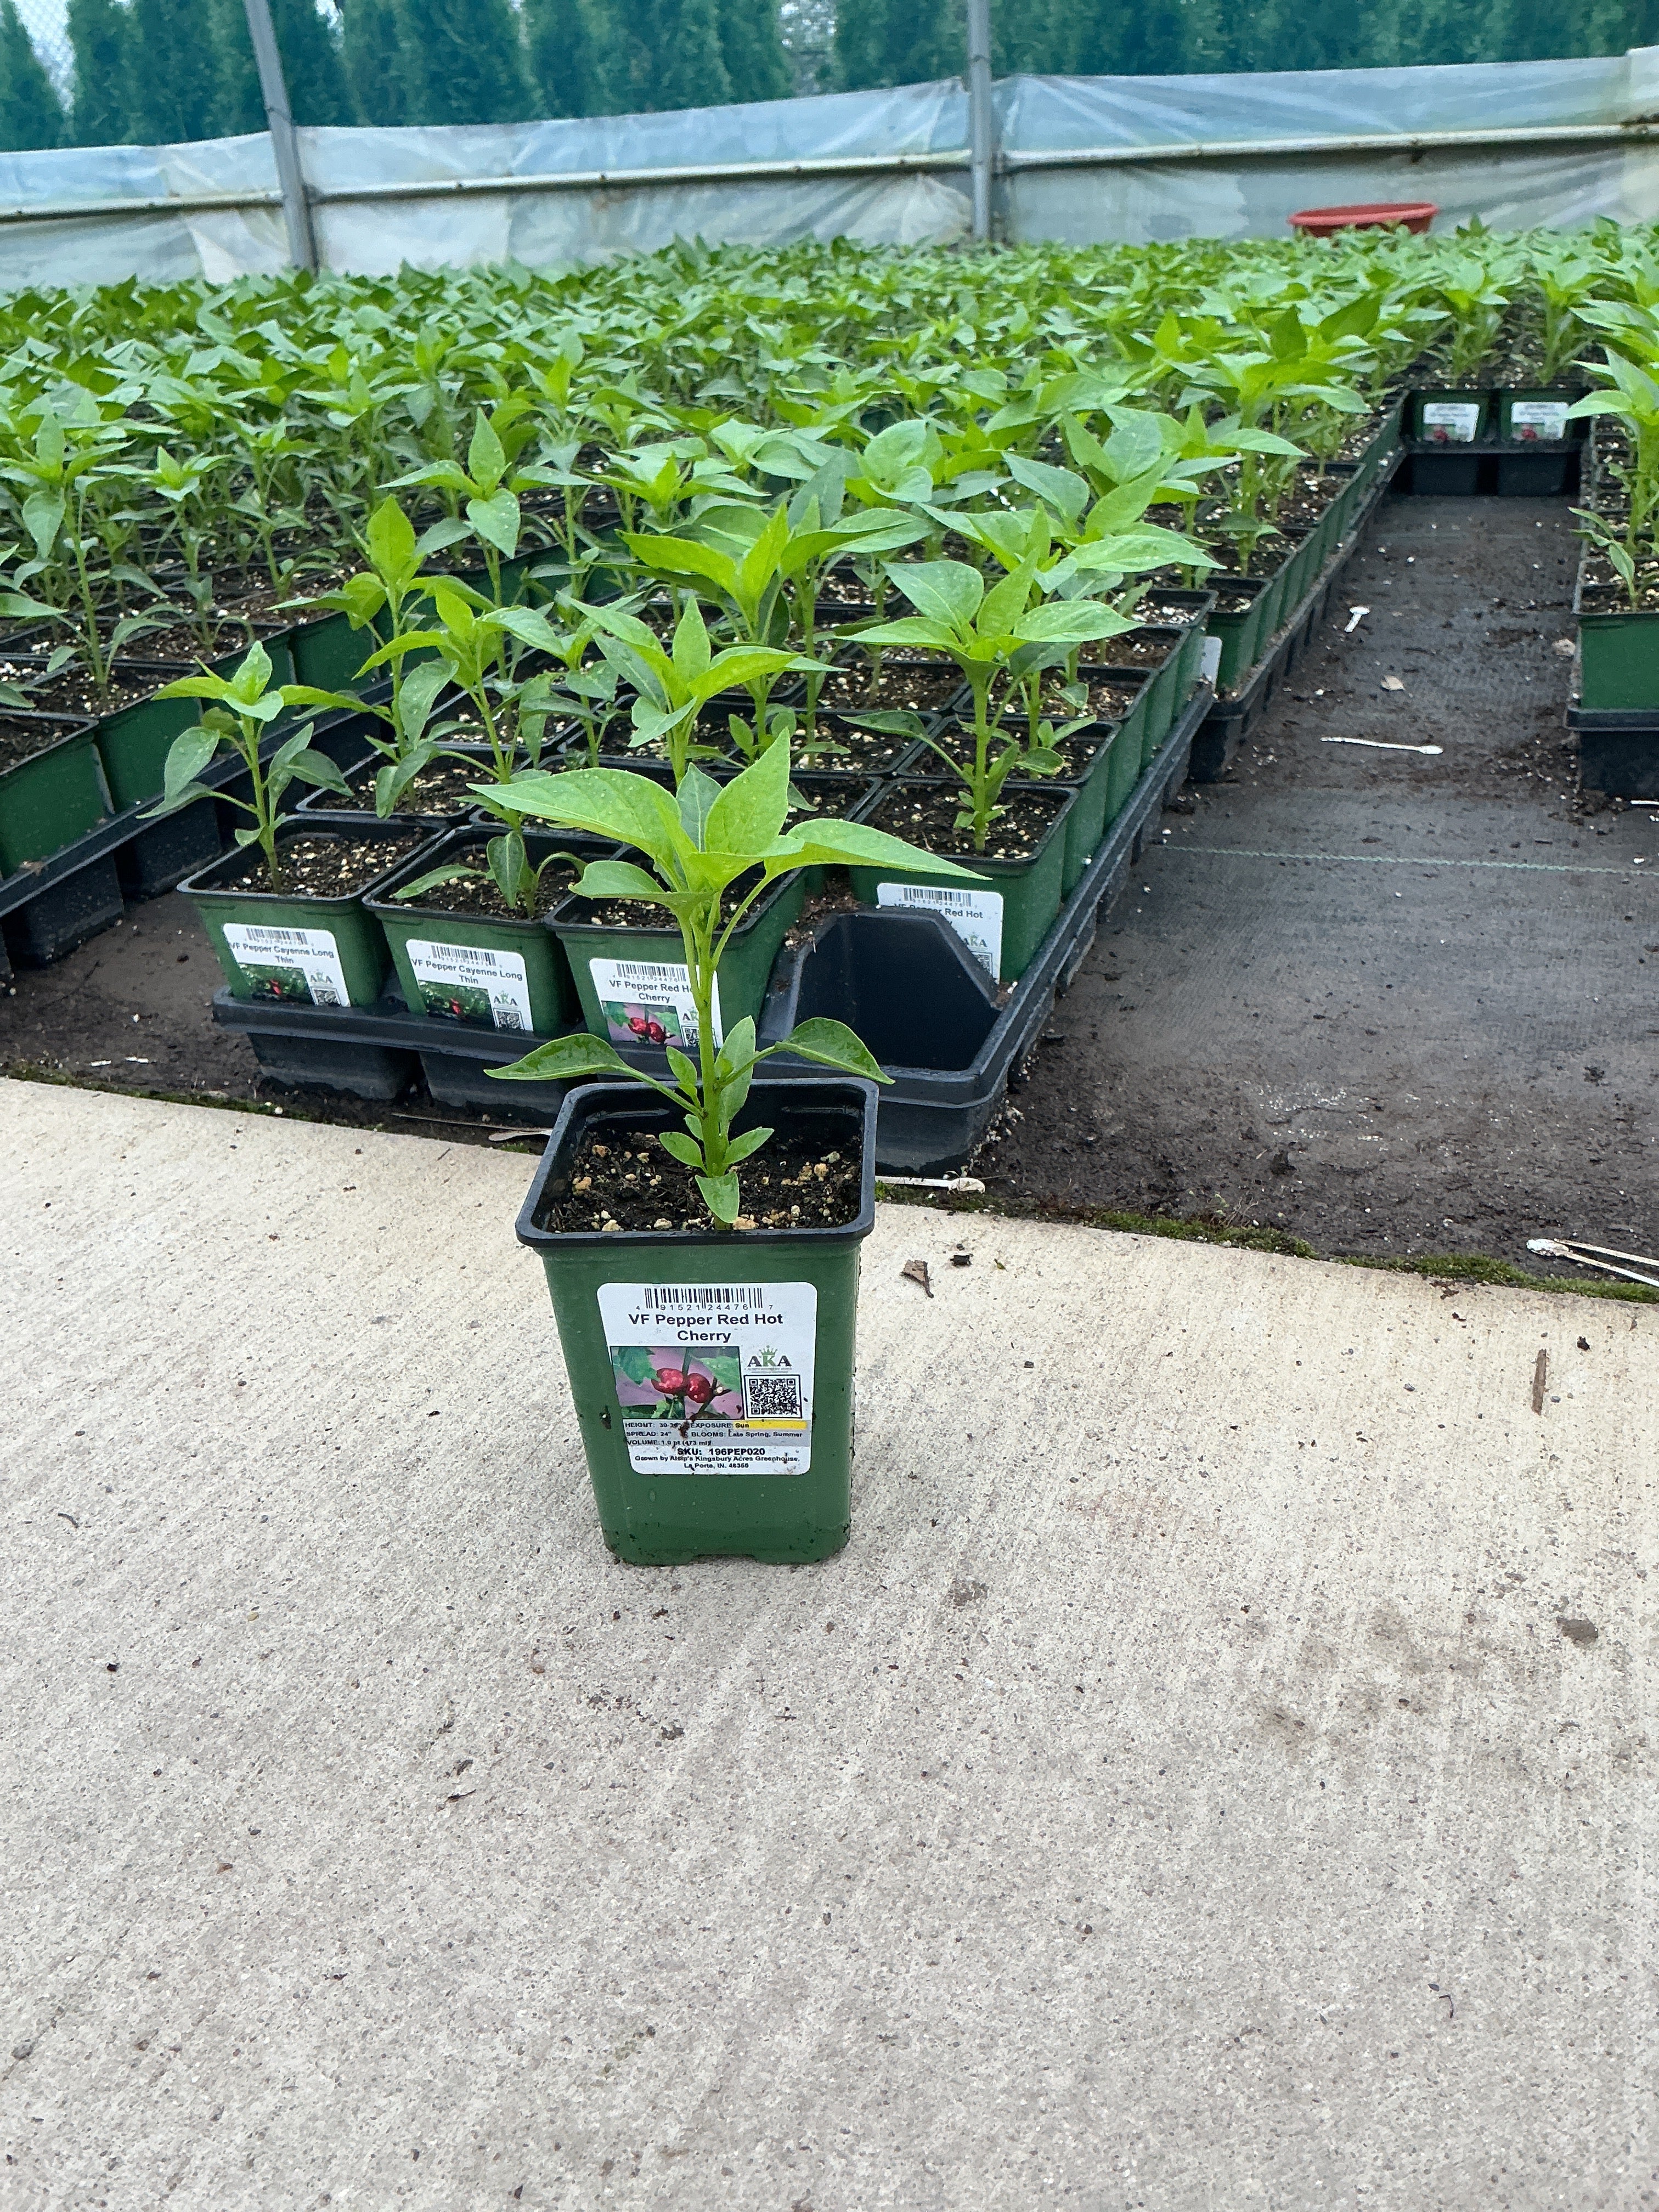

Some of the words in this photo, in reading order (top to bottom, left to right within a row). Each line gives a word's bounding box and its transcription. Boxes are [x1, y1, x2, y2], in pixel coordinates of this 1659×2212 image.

[945, 908, 963, 917] Red
[966, 910, 984, 919] Hot
[243, 944, 272, 953] Pepper
[274, 946, 311, 956] Cayenne
[312, 949, 334, 958] Long
[275, 956, 295, 964] Thin
[411, 958, 423, 967] VF
[426, 961, 456, 970] Pepper
[459, 965, 497, 976] Cayenne
[500, 970, 523, 981] Long
[459, 975, 479, 984] Thin
[609, 980, 622, 988] VF
[625, 981, 658, 991] Pepper
[661, 984, 680, 992] Red
[639, 992, 670, 1003] Cherry
[628, 1313, 650, 1324] VF
[656, 1314, 713, 1327] Pepper
[718, 1314, 749, 1325] Red
[755, 1313, 783, 1324] Hot
[678, 1330, 732, 1344] Cherry
[747, 1355, 792, 1367] AKA
